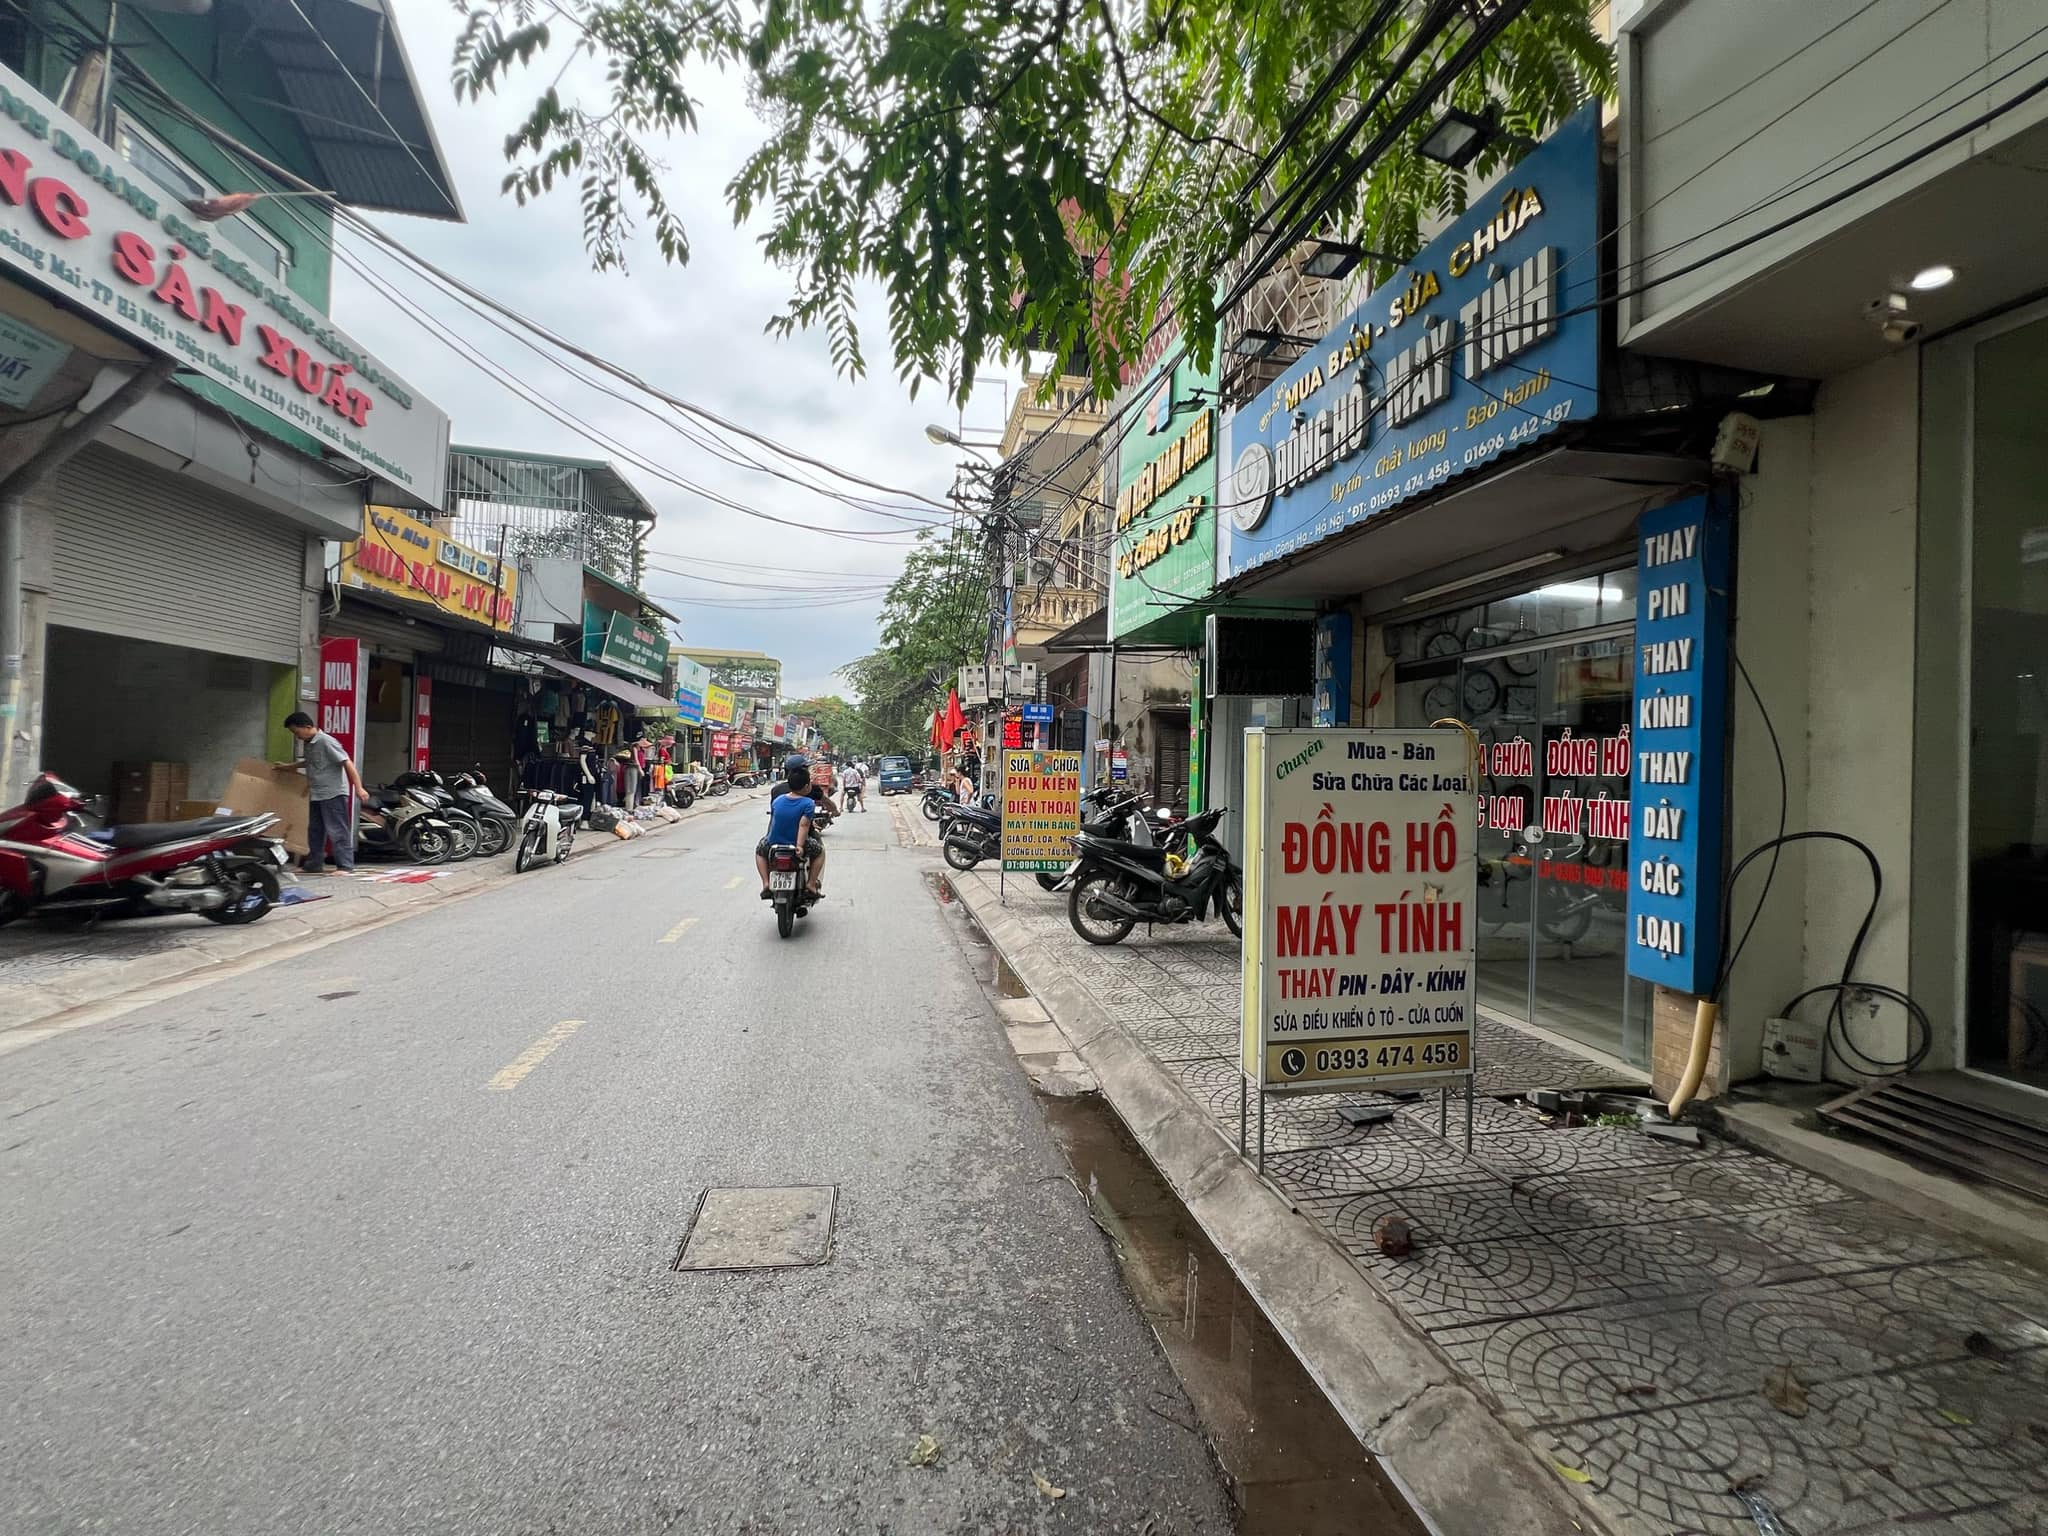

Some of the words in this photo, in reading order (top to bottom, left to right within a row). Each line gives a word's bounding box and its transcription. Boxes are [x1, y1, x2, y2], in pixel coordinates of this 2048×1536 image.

[53, 128, 159, 220] DOANH
[50, 253, 81, 289] Mai
[91, 278, 113, 306] TP
[117, 296, 137, 322] Hà
[140, 308, 166, 342] Nội
[1285, 366, 1323, 412] MUA
[1328, 324, 1372, 380] BÁN
[1389, 270, 1440, 328] SỬA
[1448, 186, 1543, 278] CHỮA
[112, 231, 246, 346] SẢN
[256, 324, 373, 427] XUẤT
[1275, 408, 1330, 496] ĐỒNG
[1333, 360, 1366, 462] HỒ
[1386, 314, 1452, 428] MÁY
[1460, 246, 1554, 380] TÍNH
[1375, 442, 1403, 479] Chất
[1408, 429, 1447, 462] lượng
[1465, 394, 1498, 431] Bảo
[1502, 367, 1551, 406] hành
[1275, 539, 1294, 556] Công
[1315, 518, 1327, 534] Hà
[1329, 512, 1345, 530] Nội
[1369, 485, 1400, 509] 01693
[1404, 475, 1423, 492] 474
[1427, 461, 1450, 481] 458
[1464, 433, 1504, 464] 01696
[1508, 417, 1538, 441] 442
[1542, 400, 1573, 426] 487
[1645, 525, 1697, 567] THAY
[355, 537, 405, 583] MUA
[408, 559, 451, 599] BÁN
[1648, 582, 1686, 620] PIN
[324, 662, 352, 691] MUA
[1642, 637, 1692, 675] THAY
[324, 700, 350, 734] BÁN
[1640, 687, 1690, 729] KÍNH
[1010, 755, 1030, 772] SỬA
[1053, 757, 1079, 772] CHỮA
[1276, 738, 1325, 781] Chuyên
[1347, 741, 1387, 760] Mua
[1403, 743, 1436, 760] Bán
[1492, 735, 1533, 776] CHỮA
[1547, 727, 1597, 776] ĐỒNG
[1602, 724, 1630, 777] HỒ
[1639, 751, 1691, 784] THAY
[1008, 776, 1037, 793] PHỤ
[1042, 776, 1076, 793] KIỆN
[1312, 770, 1345, 791] Sửa
[1351, 773, 1393, 791] Chữa
[1399, 773, 1428, 791] Các
[1432, 774, 1467, 794] Loại
[1008, 797, 1037, 816] ĐIỆN
[1041, 801, 1076, 817] THOẠI
[1489, 795, 1524, 838] LOẠI
[1543, 790, 1583, 835] MÁY
[1587, 791, 1630, 840] TÍNH
[1644, 798, 1684, 841] DÂY
[1281, 802, 1390, 874] ĐỒNG
[1406, 802, 1456, 873] HỒ
[1042, 860, 1058, 870] 153
[1640, 855, 1680, 896] CÁC
[1277, 891, 1362, 958] MÁY
[1375, 890, 1462, 954] TÍNH
[1637, 914, 1682, 959] LOẠI
[1278, 968, 1335, 999] THAY
[1338, 974, 1368, 996] PIN
[1380, 968, 1414, 994] DÂY
[1425, 964, 1466, 992] KÍNH
[1274, 1009, 1297, 1032] SỬA
[1332, 1004, 1363, 1029] KHIỂN
[1367, 1008, 1376, 1027] Ô
[1380, 1006, 1394, 1026] TÔ
[1408, 1003, 1431, 1025] CỬA
[1435, 1001, 1464, 1023] CUỐN
[1316, 1048, 1369, 1071] 0393
[1376, 1045, 1414, 1068] 474
[1422, 1043, 1460, 1064] 458
